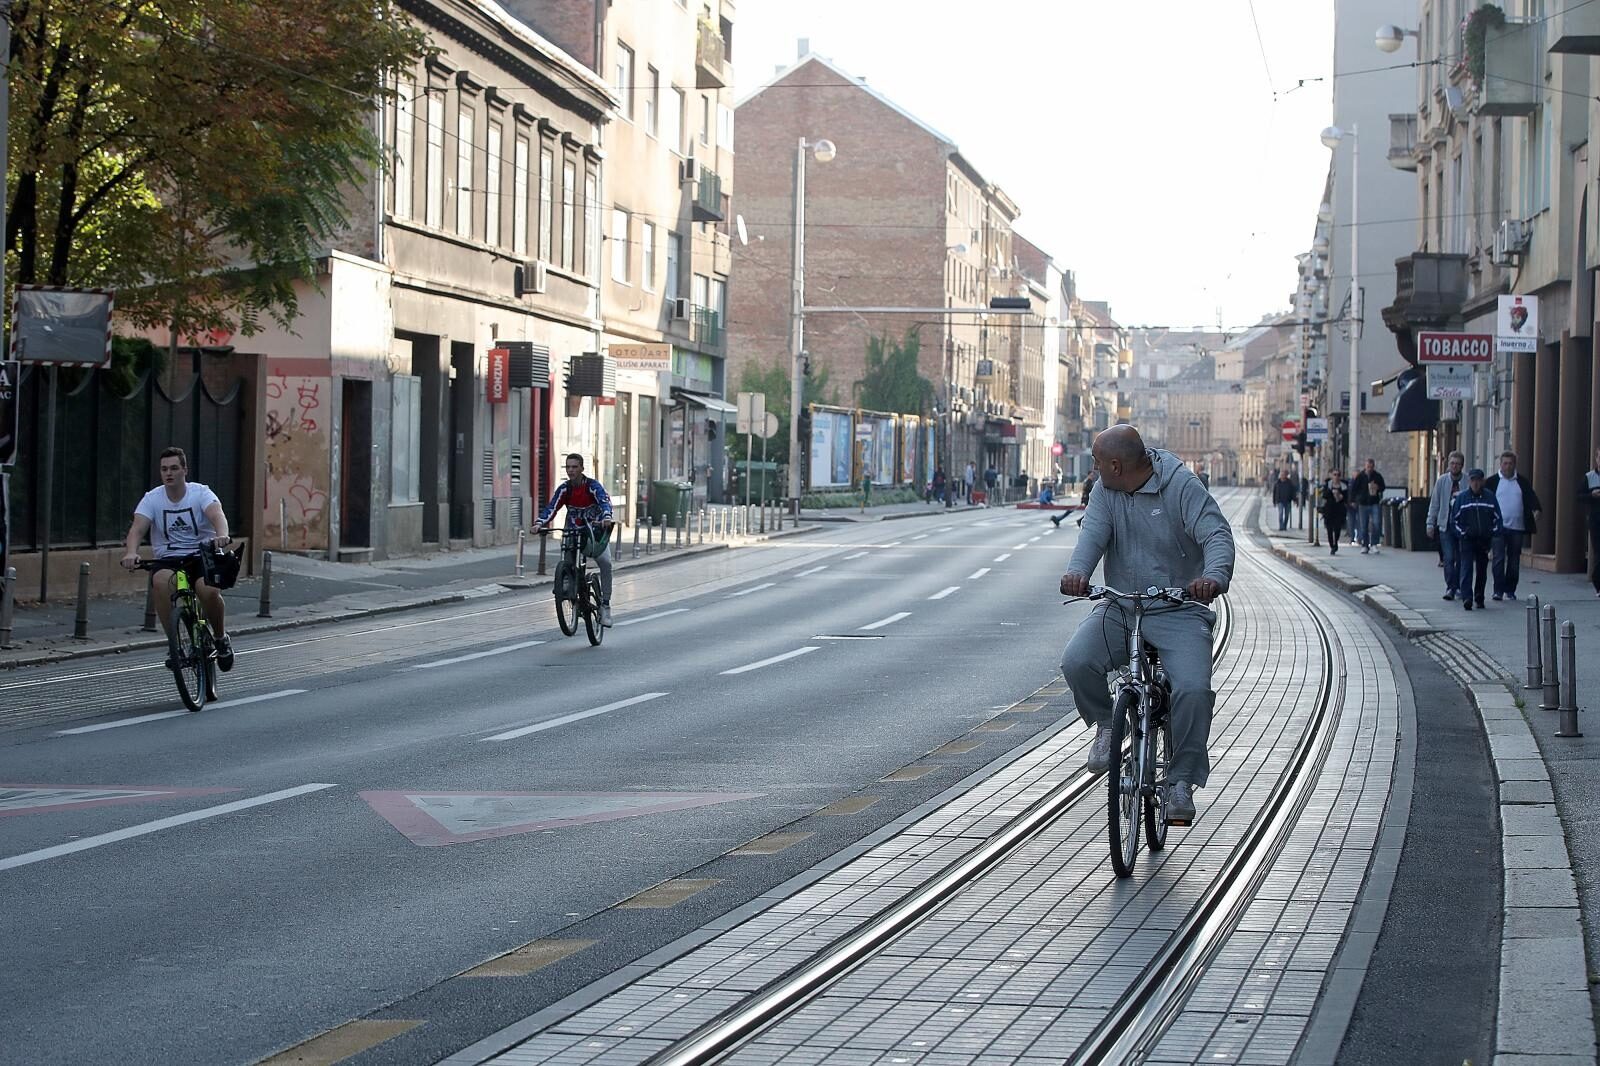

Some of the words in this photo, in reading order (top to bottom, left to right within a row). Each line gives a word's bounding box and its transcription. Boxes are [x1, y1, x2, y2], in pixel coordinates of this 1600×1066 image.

[1424, 338, 1489, 357] TOBACCO
[640, 361, 669, 369] APARATI
[493, 355, 503, 399] KONZUM
[1433, 386, 1462, 398] Stella
